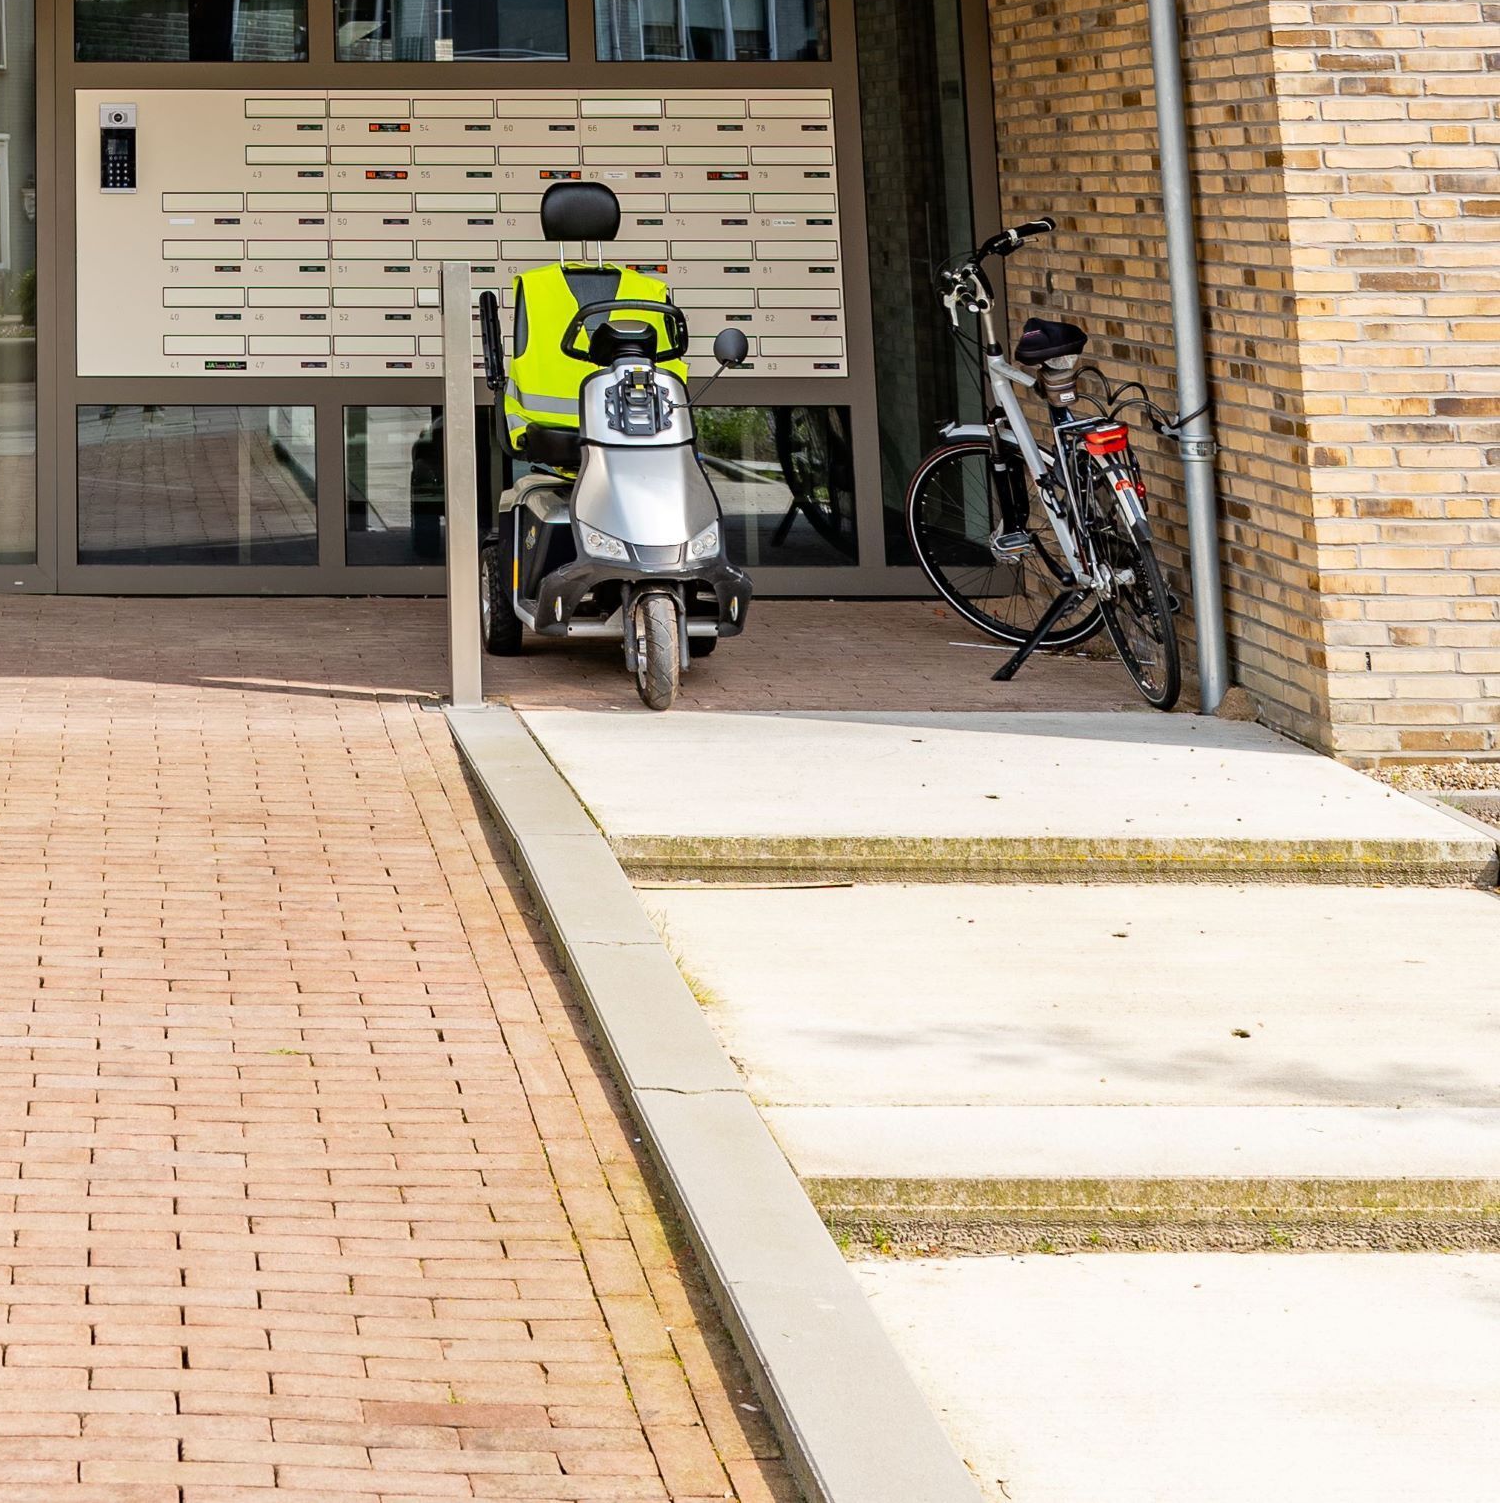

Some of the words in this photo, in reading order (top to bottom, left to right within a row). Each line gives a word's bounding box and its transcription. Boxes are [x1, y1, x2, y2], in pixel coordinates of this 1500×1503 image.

[420, 124, 429, 132] 54
[672, 124, 681, 132] 72
[253, 170, 262, 179] 43
[337, 171, 346, 179] 49
[421, 171, 430, 179] 55
[505, 171, 514, 179] 61
[254, 218, 263, 226] 44
[338, 218, 347, 226] 50
[422, 218, 432, 226] 56
[507, 218, 516, 226] 62
[508, 266, 517, 274] 63
[678, 266, 687, 274] 75
[170, 313, 179, 321] 40
[255, 313, 264, 321] 46
[339, 313, 349, 321] 52
[424, 313, 434, 321] 58
[765, 314, 775, 322] 82
